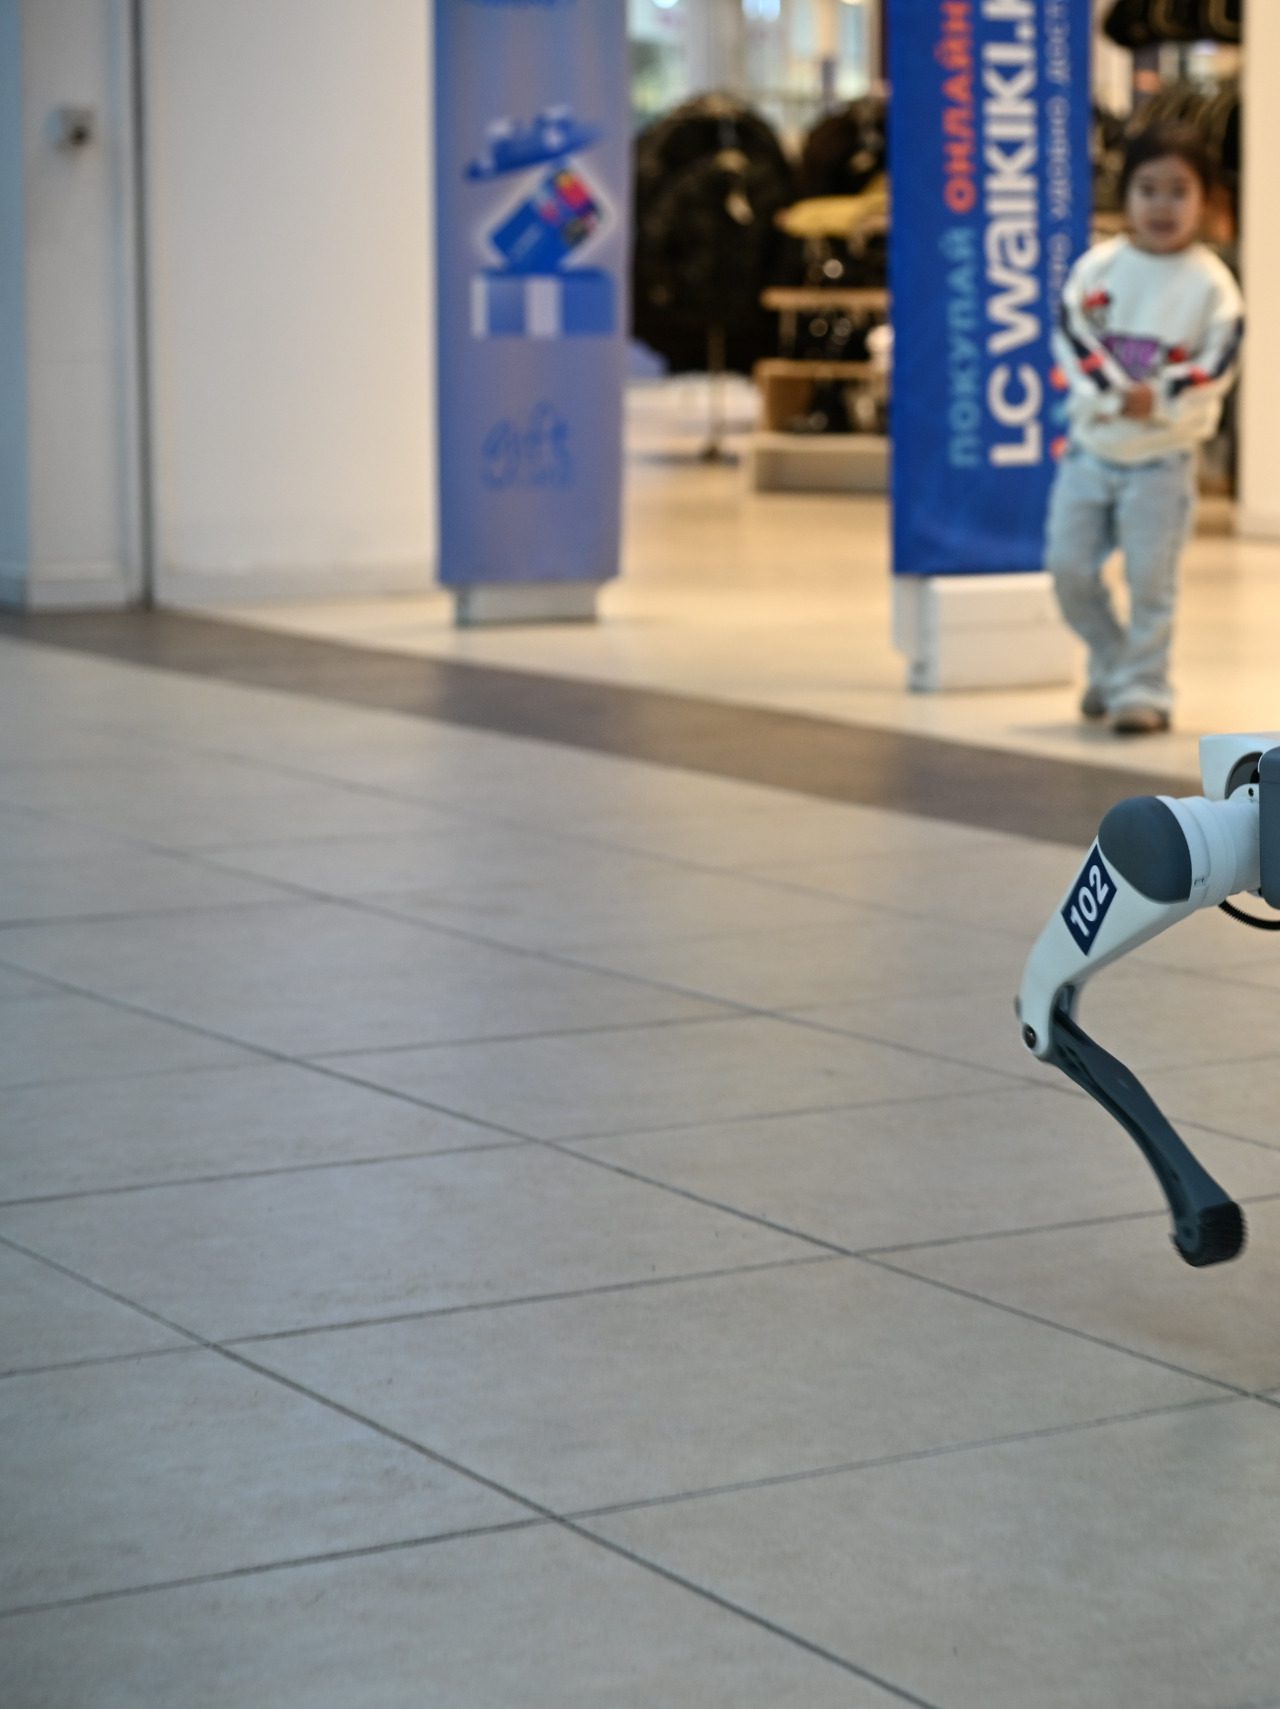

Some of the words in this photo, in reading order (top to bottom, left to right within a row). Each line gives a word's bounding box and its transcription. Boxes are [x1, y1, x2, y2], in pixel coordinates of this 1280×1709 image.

[935, 0, 976, 213] ОНЛАЙН
[939, 227, 979, 467] ПОКУПАЙ
[989, 363, 1042, 466] LC
[1070, 865, 1109, 937] 102
